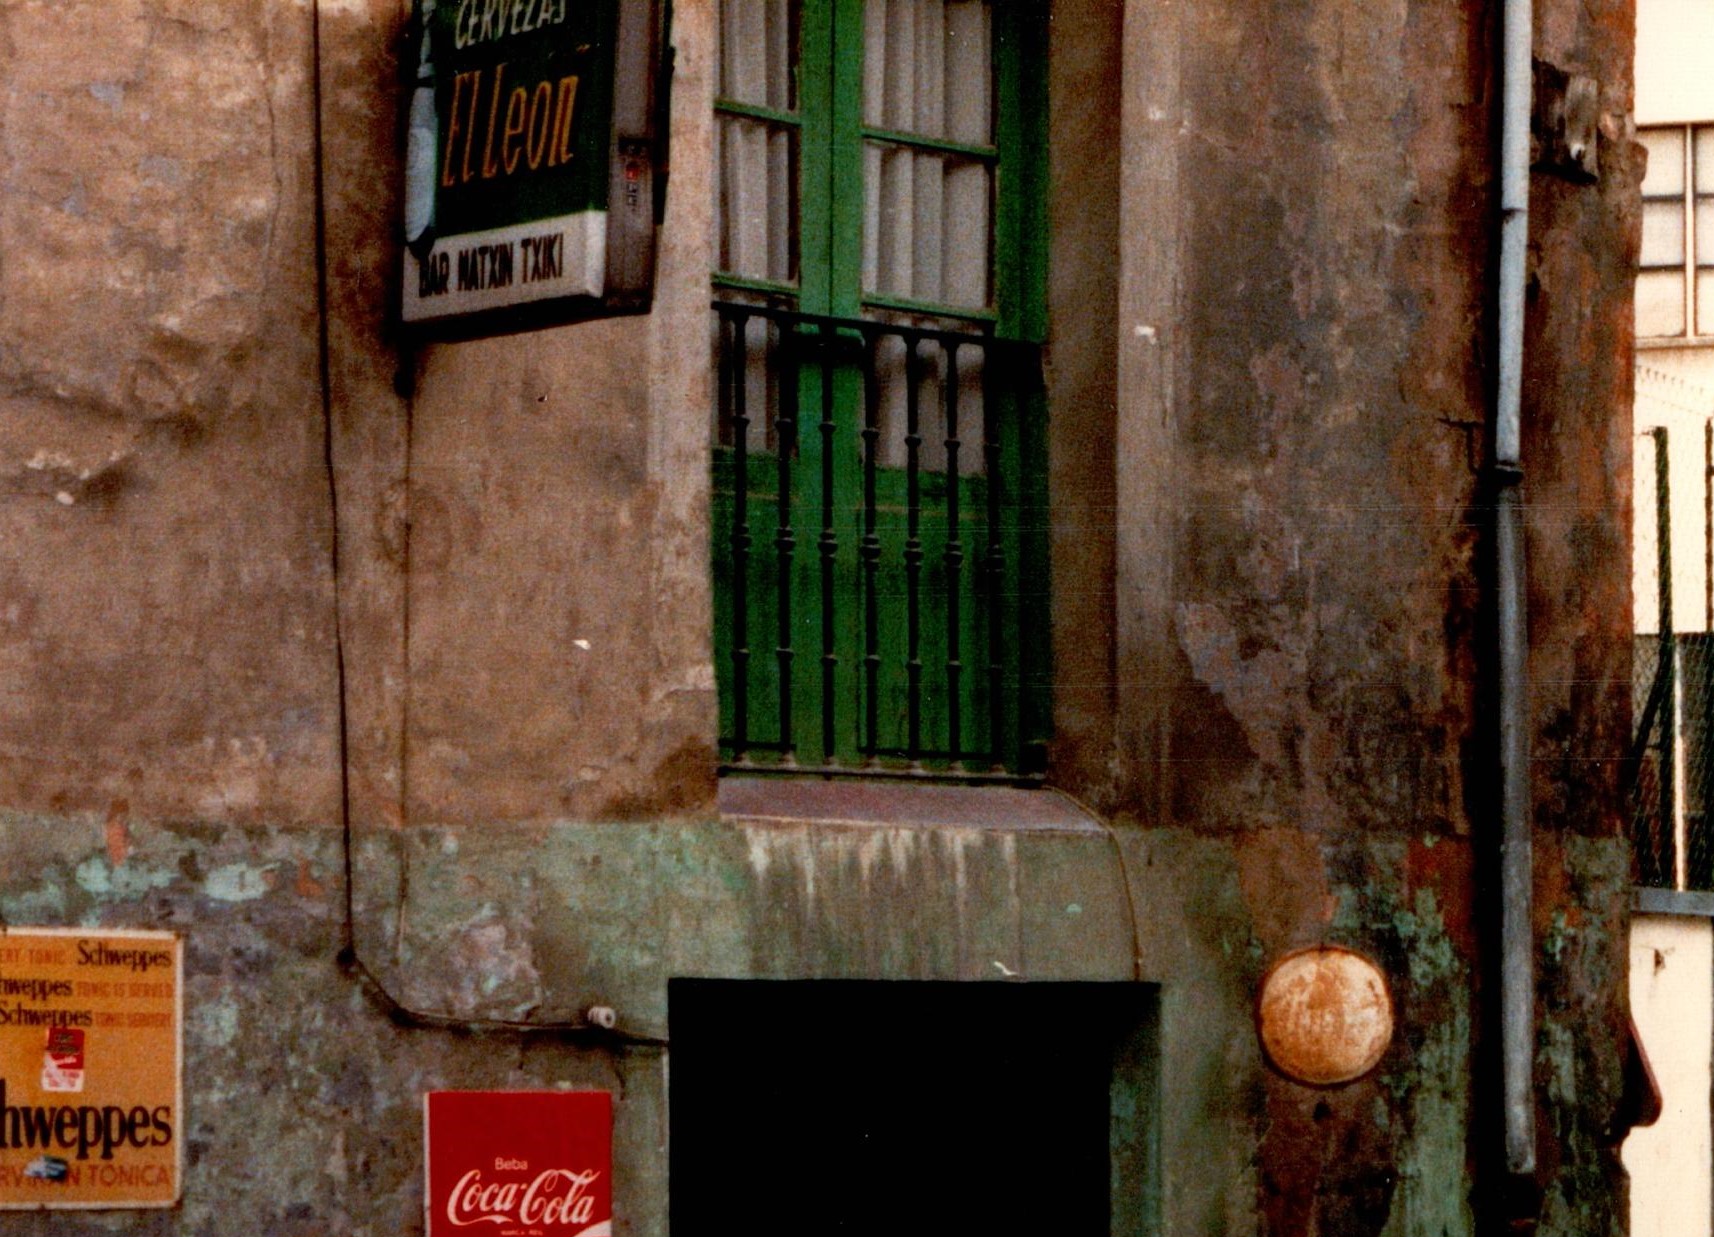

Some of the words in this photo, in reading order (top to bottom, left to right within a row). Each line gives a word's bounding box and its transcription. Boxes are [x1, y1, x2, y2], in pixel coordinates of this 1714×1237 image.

[418, 252, 450, 298] BAR
[457, 242, 514, 291] MATXIN
[521, 233, 564, 283] TXIKI
[77, 939, 173, 972] Schweppes
[0, 1001, 94, 1029] Schweppes
[495, 1157, 528, 1171] Beba
[447, 1169, 600, 1226] Coca-Cola
